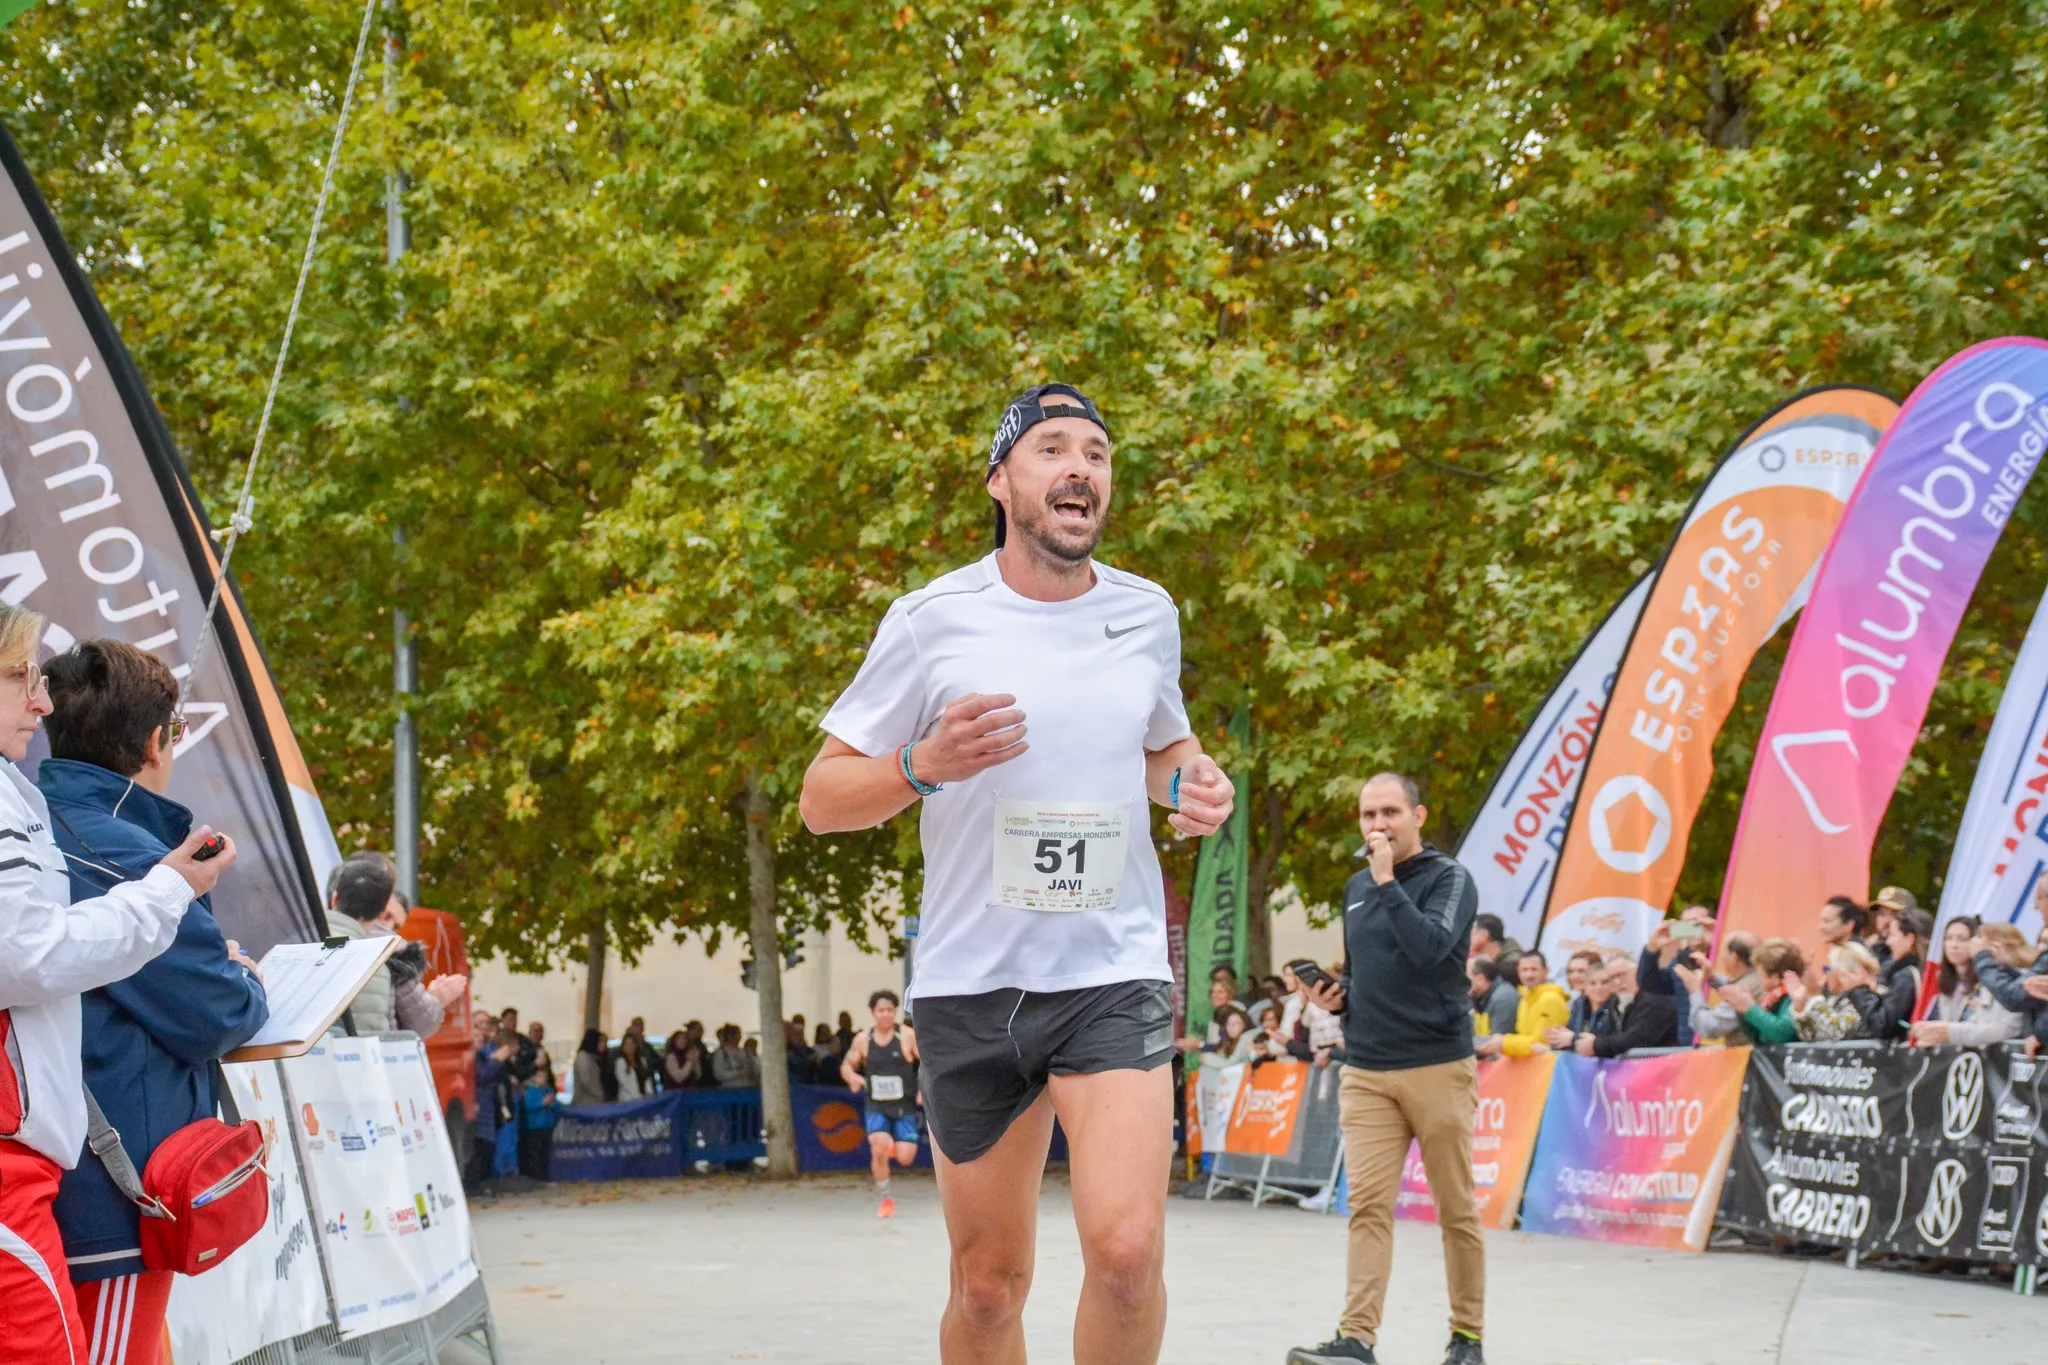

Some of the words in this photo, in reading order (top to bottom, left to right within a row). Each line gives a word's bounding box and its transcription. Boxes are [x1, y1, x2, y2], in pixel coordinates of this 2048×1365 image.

[1795, 448, 1867, 465] ESPIA
[1836, 382, 2035, 719] alumbra
[1493, 701, 1602, 876] MONZÓN
[1004, 828, 1040, 838] CARRERA
[1041, 831, 1082, 839] EMPRESAS
[1083, 830, 1111, 839] MONZÓN
[1033, 838, 1086, 874] 51
[1047, 879, 1082, 890] JAVI
[1761, 1145, 1860, 1186] Automóviles
[1766, 1183, 1871, 1239] CABRERO
